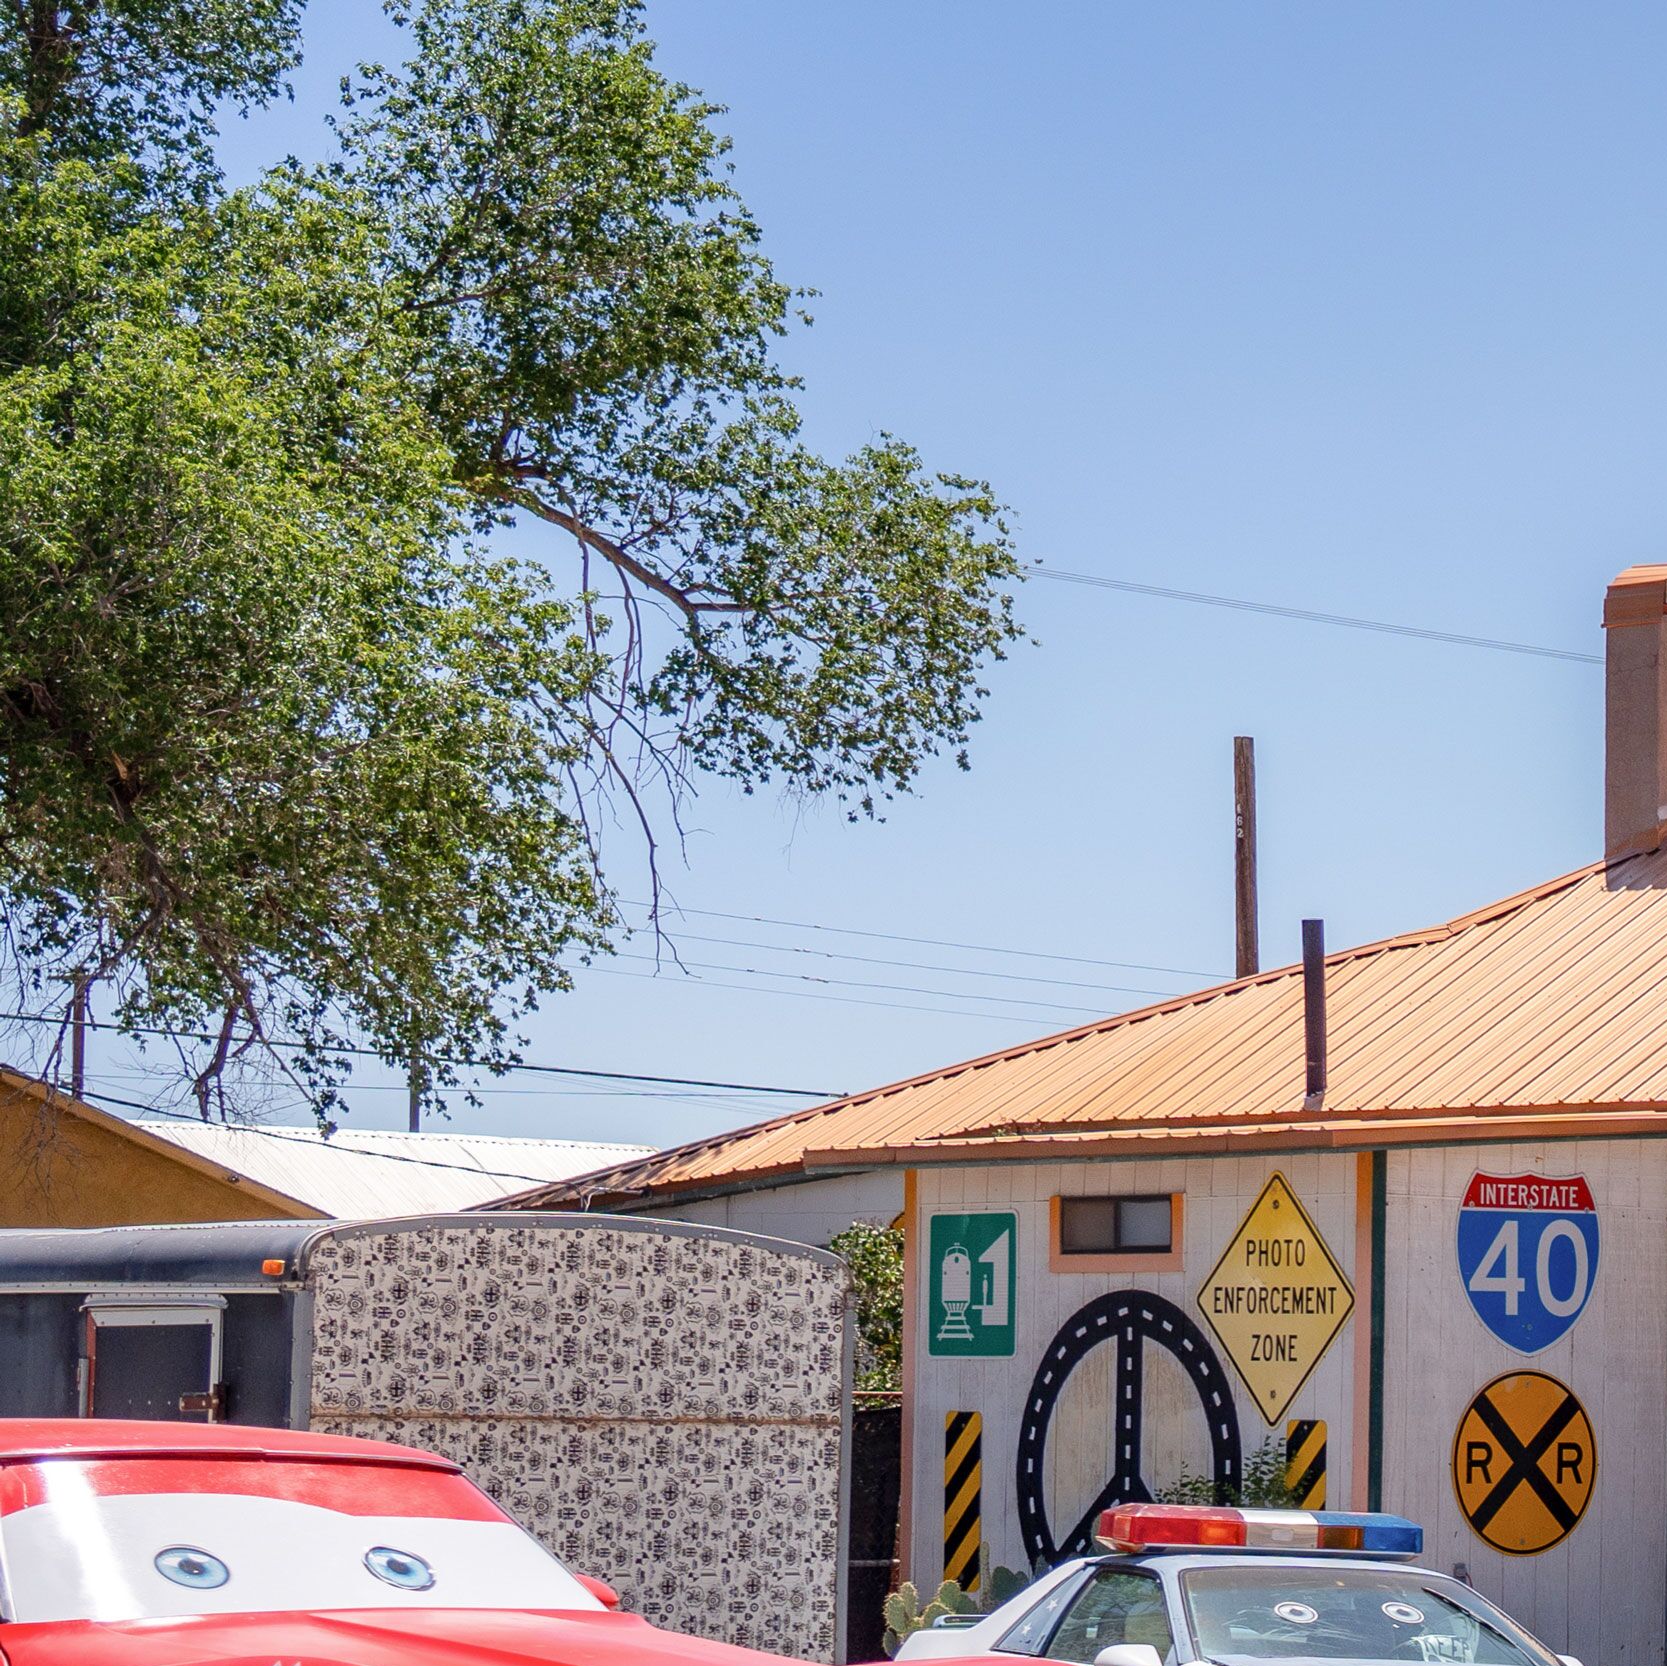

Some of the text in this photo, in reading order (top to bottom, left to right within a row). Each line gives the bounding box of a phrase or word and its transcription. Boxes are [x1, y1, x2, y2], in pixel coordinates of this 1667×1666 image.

[1480, 1182, 1580, 1208] INTERSTATE
[1246, 1239, 1306, 1267] PHOTO
[1469, 1219, 1589, 1317] 40
[1213, 1286, 1338, 1316] ENFORCEMENT
[1251, 1335, 1298, 1362] ZONE
